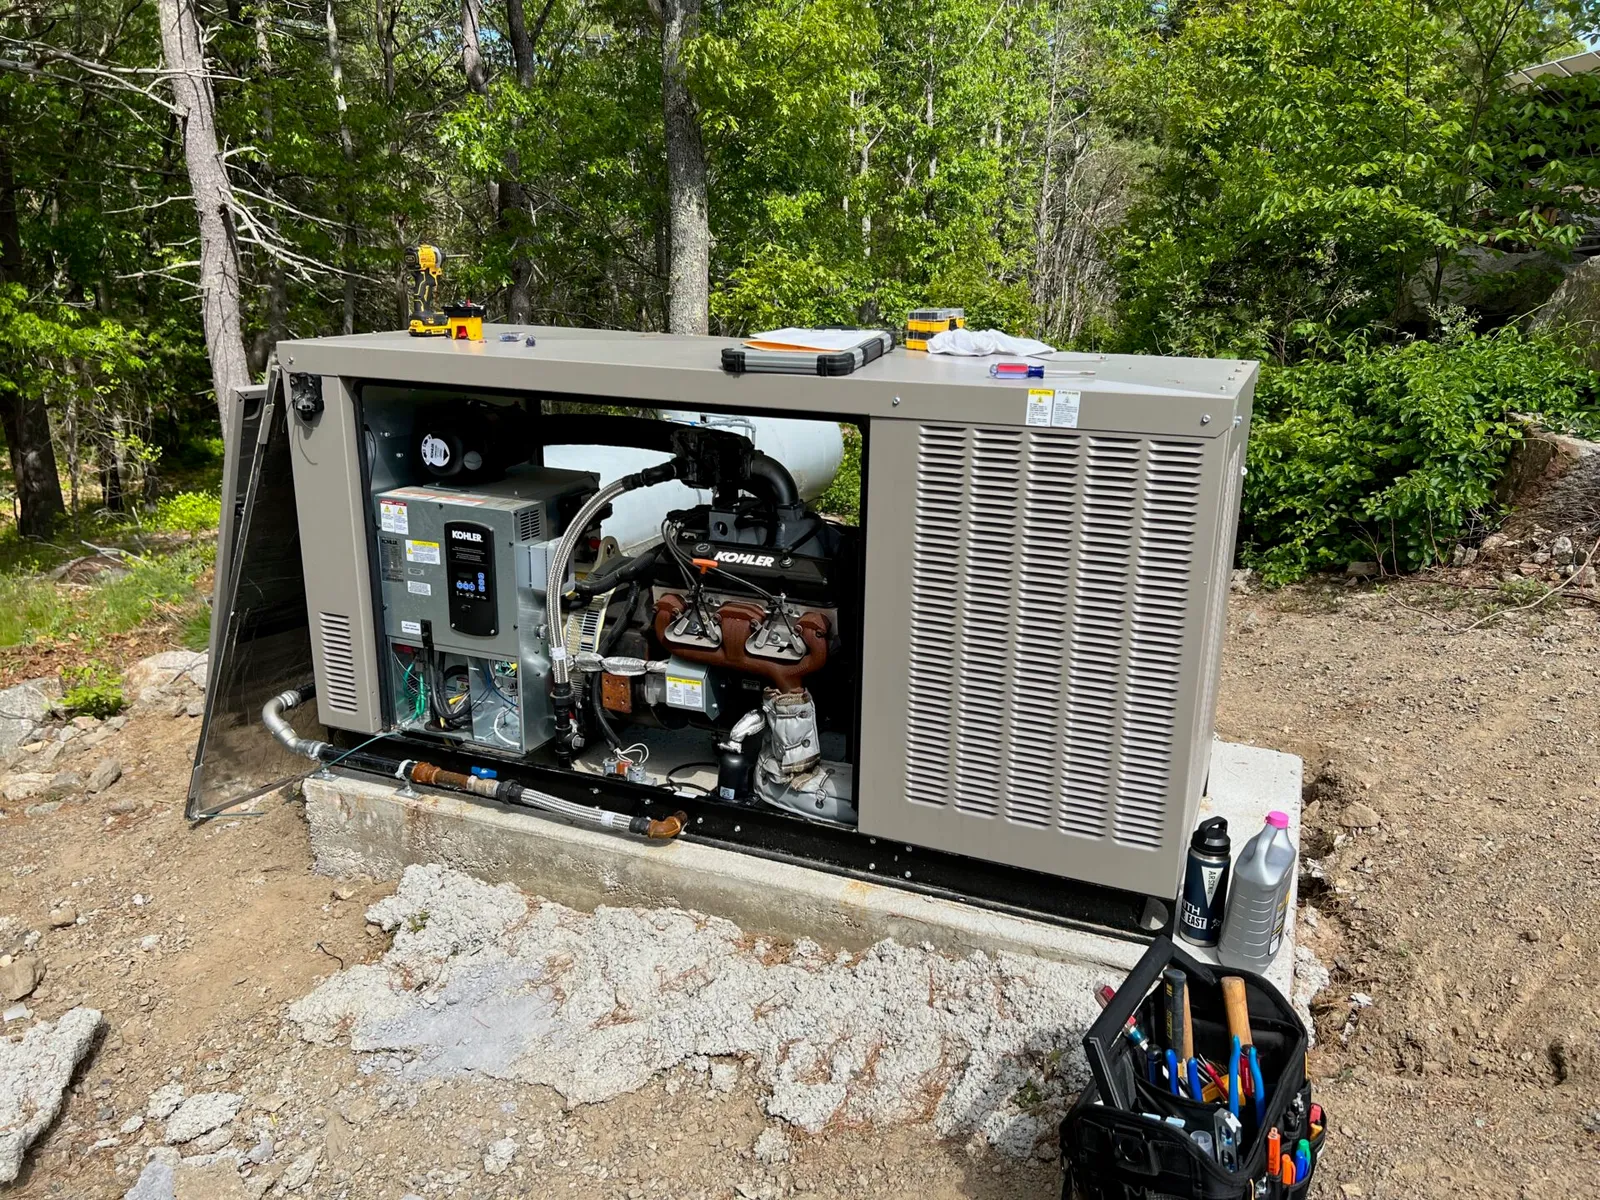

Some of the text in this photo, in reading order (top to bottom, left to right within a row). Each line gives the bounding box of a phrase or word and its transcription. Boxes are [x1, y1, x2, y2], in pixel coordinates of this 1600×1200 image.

[452, 530, 483, 543] KOHLER
[713, 551, 775, 567] KOHLER
[1187, 914, 1206, 928] EAST
